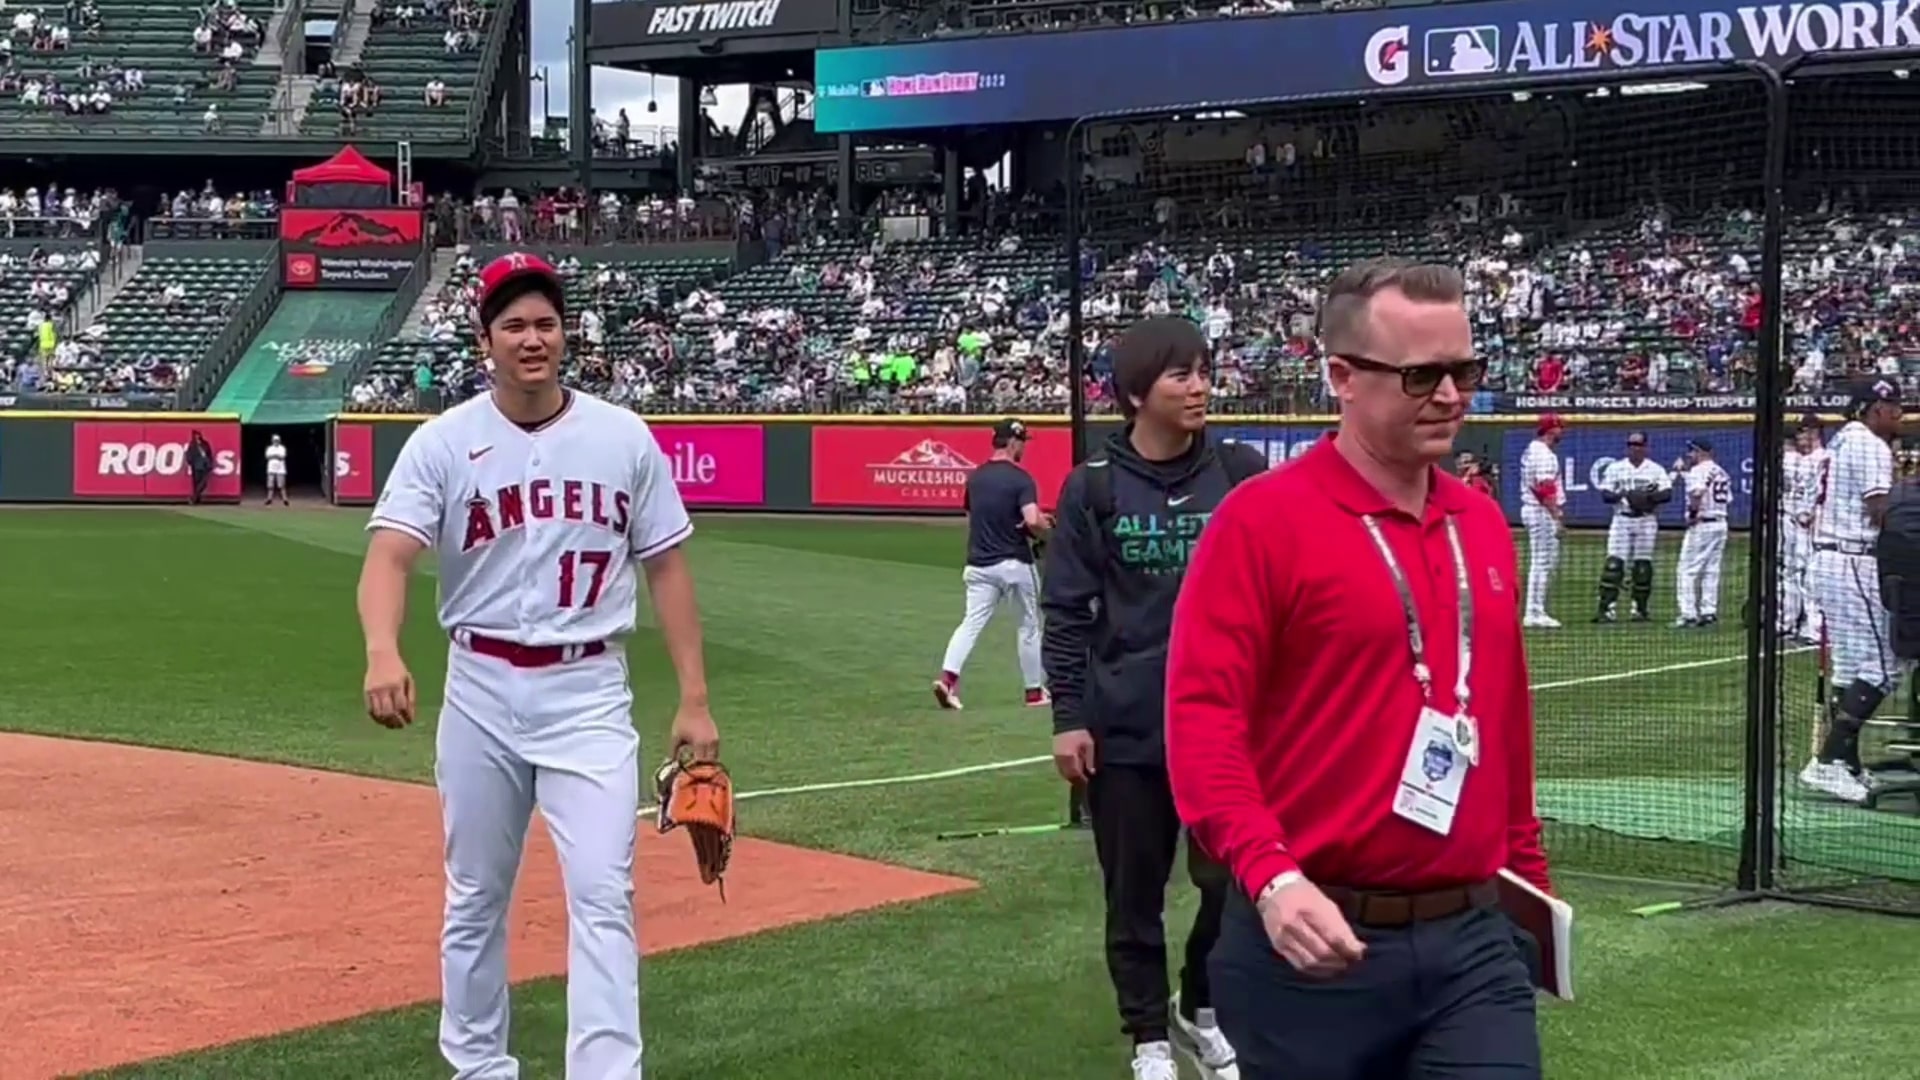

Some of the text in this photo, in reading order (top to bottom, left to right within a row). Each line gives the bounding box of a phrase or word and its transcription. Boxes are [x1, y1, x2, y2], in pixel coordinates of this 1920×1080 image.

[647, 0, 781, 34] FAST TWITCH
[1737, 0, 1920, 57] WORK
[663, 442, 716, 484] ile
[873, 469, 968, 484] MUCKLESHO
[462, 479, 630, 553] ANGELS
[557, 550, 613, 609] 17
